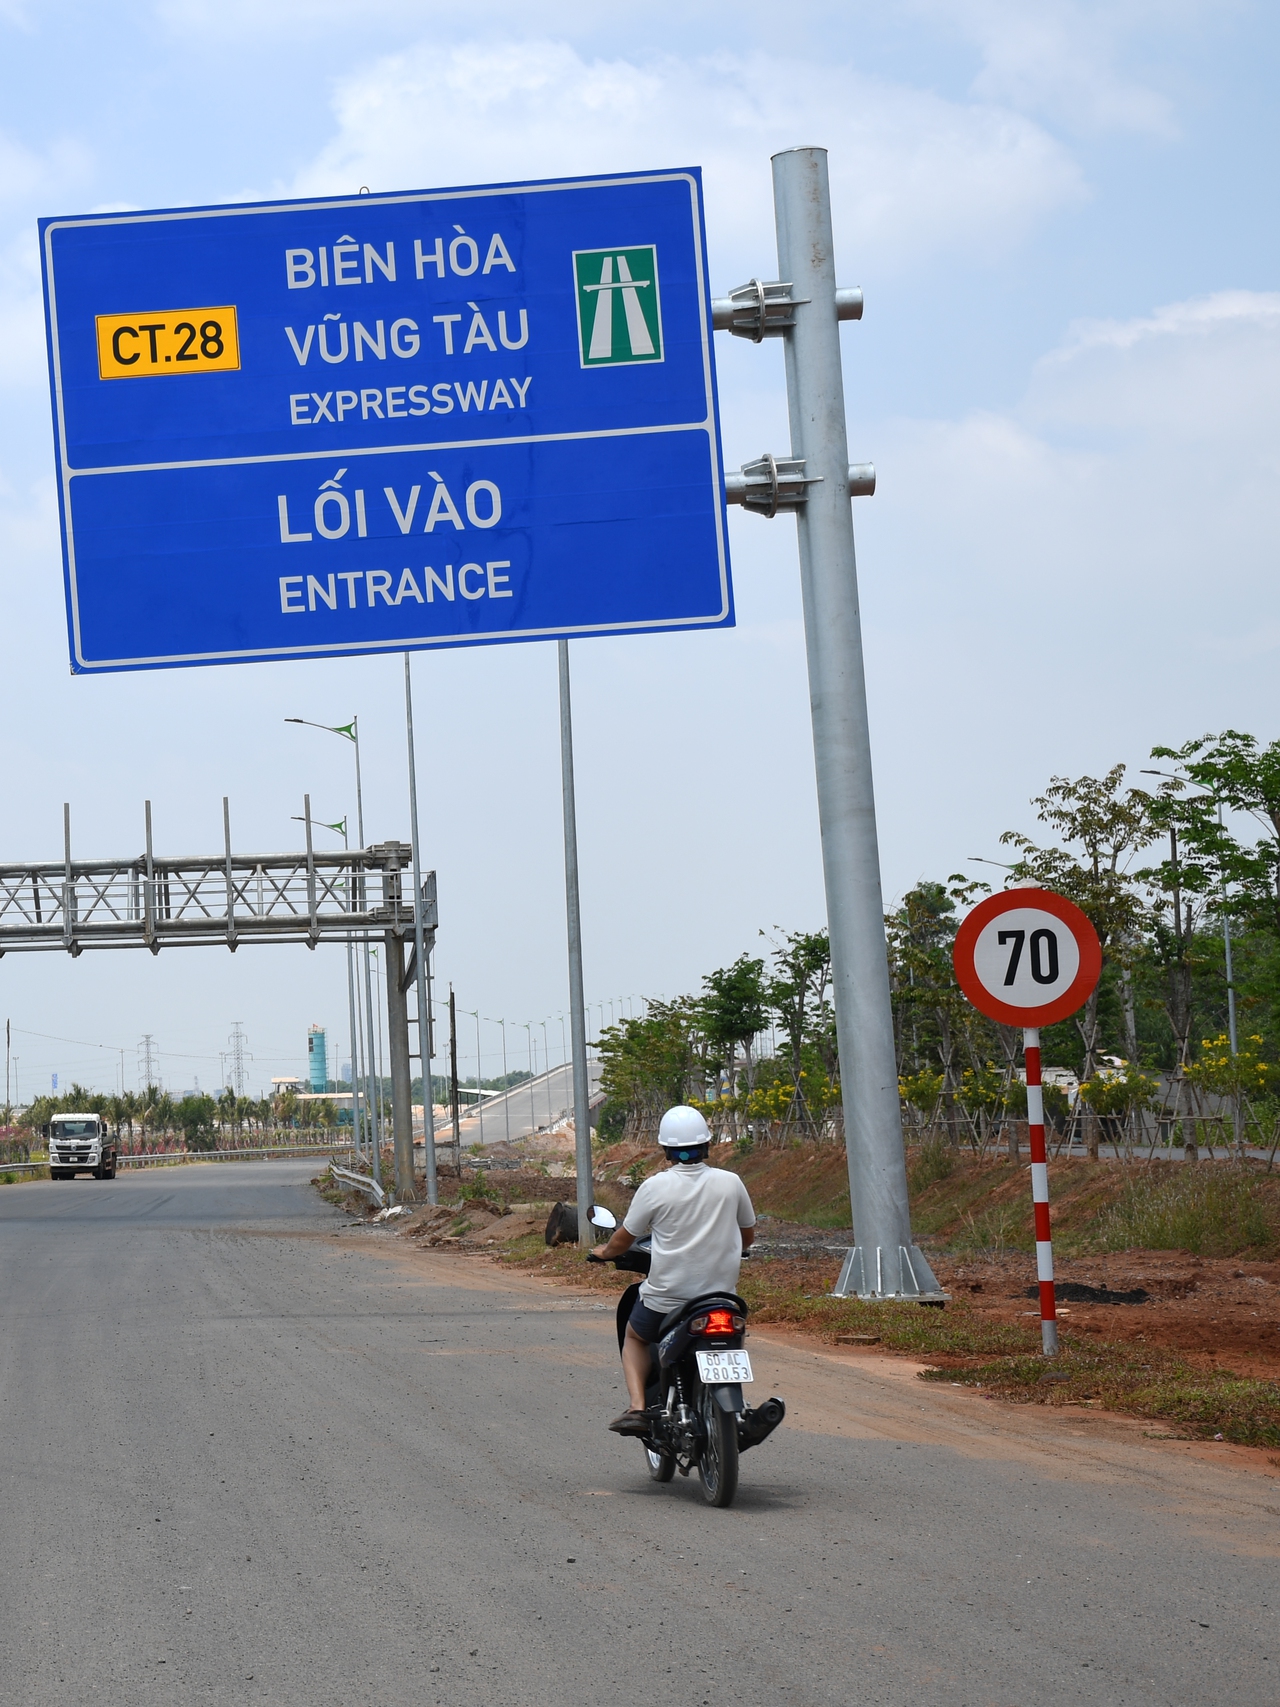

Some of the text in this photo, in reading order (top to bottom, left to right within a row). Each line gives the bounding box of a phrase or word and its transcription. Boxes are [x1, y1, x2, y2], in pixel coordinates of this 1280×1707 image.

[286, 225, 517, 290] BIÊN HÒA
[112, 320, 225, 366] CT.28
[284, 302, 529, 366] VŨNG TÀU
[289, 377, 533, 425] EXPRESSWAY
[277, 469, 502, 544] LỐI VÀO
[278, 561, 513, 614] ENTRANCE
[997, 928, 1060, 987] 70
[703, 1367, 749, 1380] 280.53
